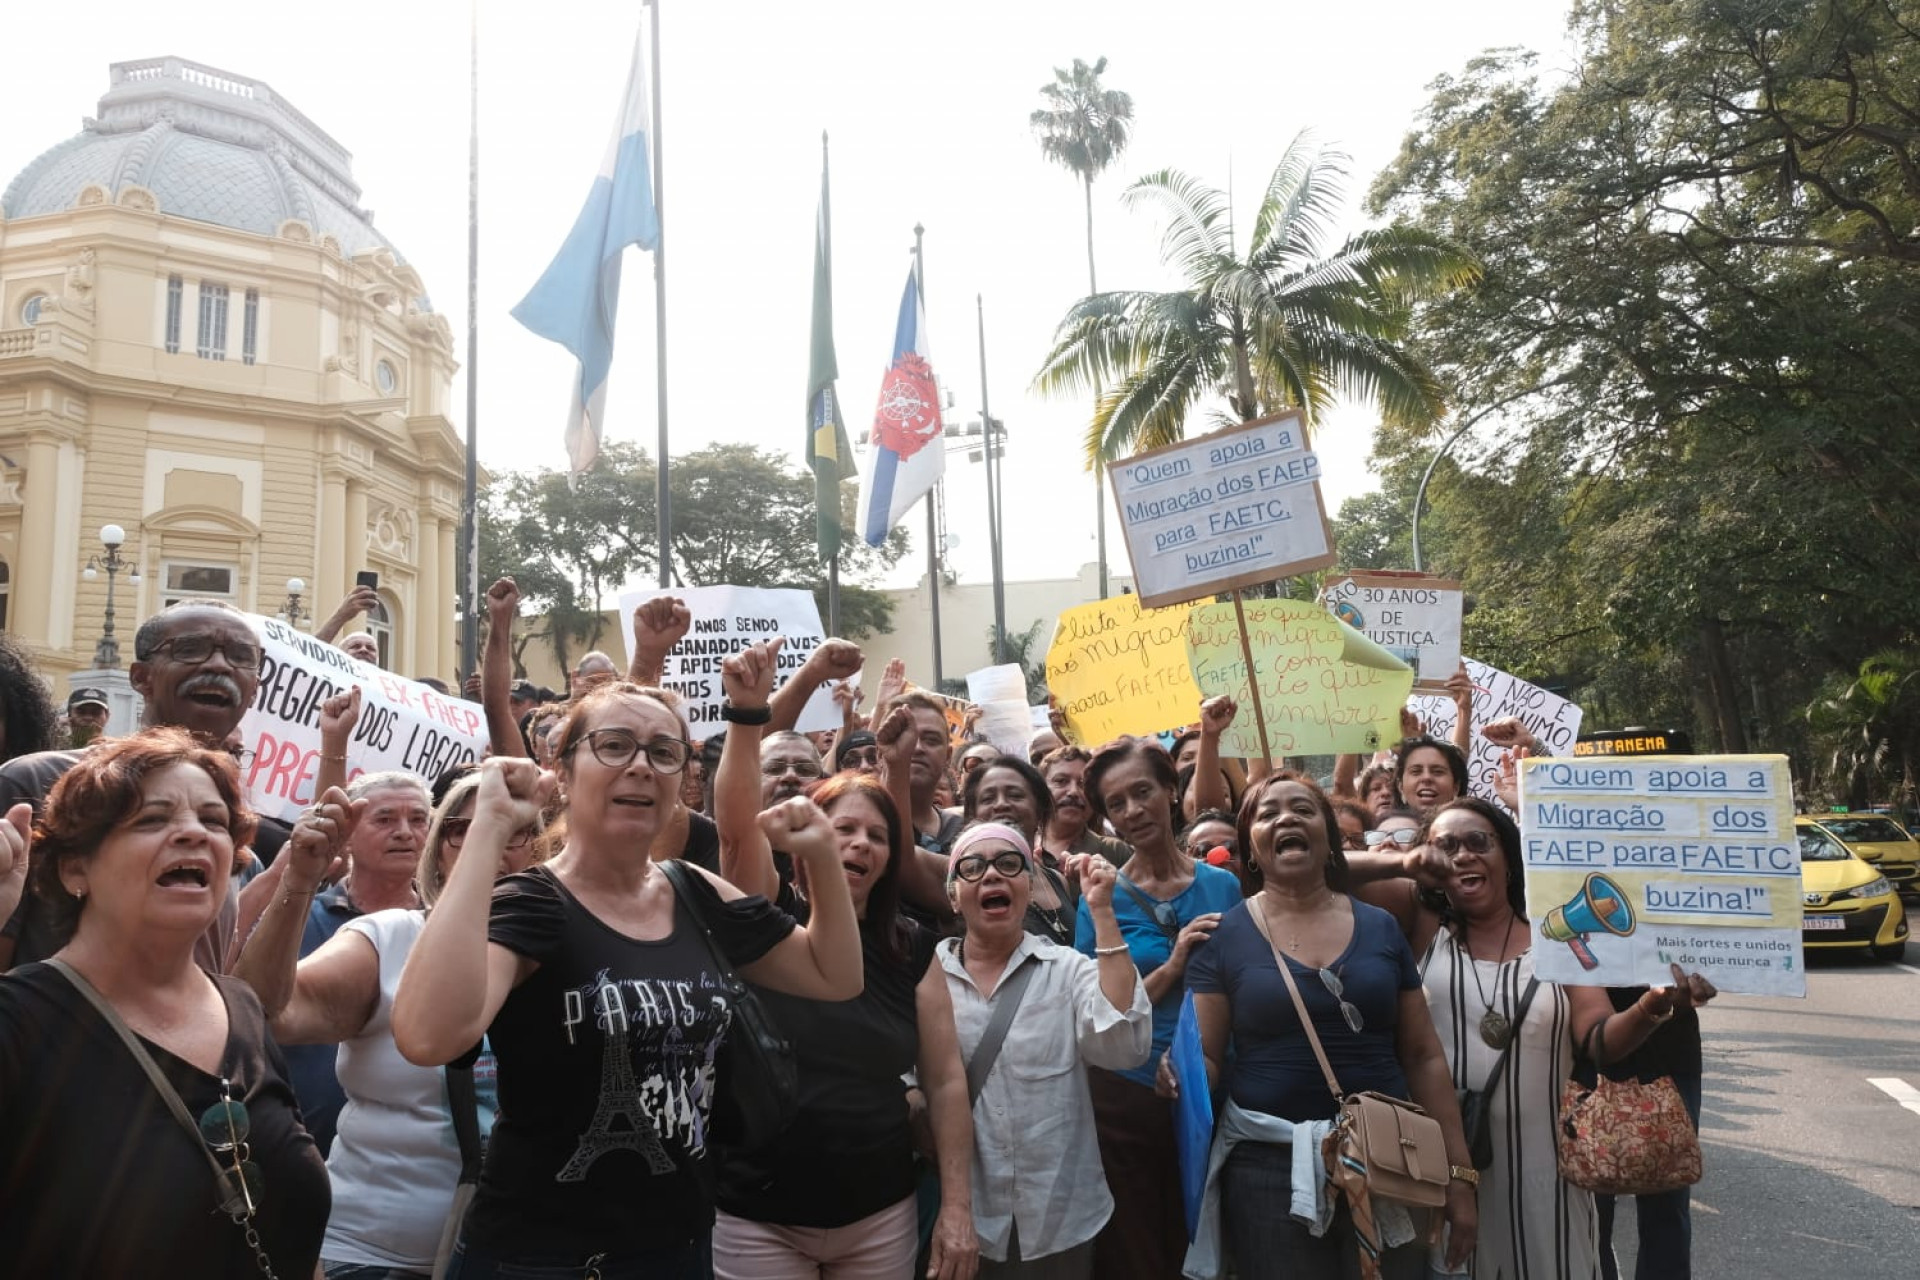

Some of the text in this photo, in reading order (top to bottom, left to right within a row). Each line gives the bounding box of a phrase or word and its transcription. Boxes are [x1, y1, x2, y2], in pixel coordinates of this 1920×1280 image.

[1126, 431, 1291, 485] "Quem apoia a
[1126, 456, 1319, 523] Migração dos FAEP
[1155, 524, 1197, 551] para
[1185, 534, 1264, 570] buzina!"
[1326, 581, 1438, 608] SÃO 30 ANOS
[695, 617, 779, 634] ANOS SENDO
[1381, 611, 1404, 626] DE
[1362, 630, 1440, 649] JUSTIÇA.
[1115, 662, 1191, 699] FAETEC
[378, 675, 480, 738] EX-FAEP
[1504, 678, 1547, 710] NÃO
[1554, 701, 1574, 723] É
[354, 701, 399, 753] DOS
[1596, 736, 1666, 755] IPANEMA
[1540, 763, 1766, 791] "Quem apoia a
[1537, 803, 1767, 831] Migração dos
[1528, 840, 1605, 861] FAEP
[1613, 845, 1676, 867] para
[1646, 884, 1765, 911] buzina!"
[1656, 936, 1792, 951] Mais fortes e unidos
[1678, 953, 1771, 967] do que nunca
[564, 981, 694, 1045] PARIS
